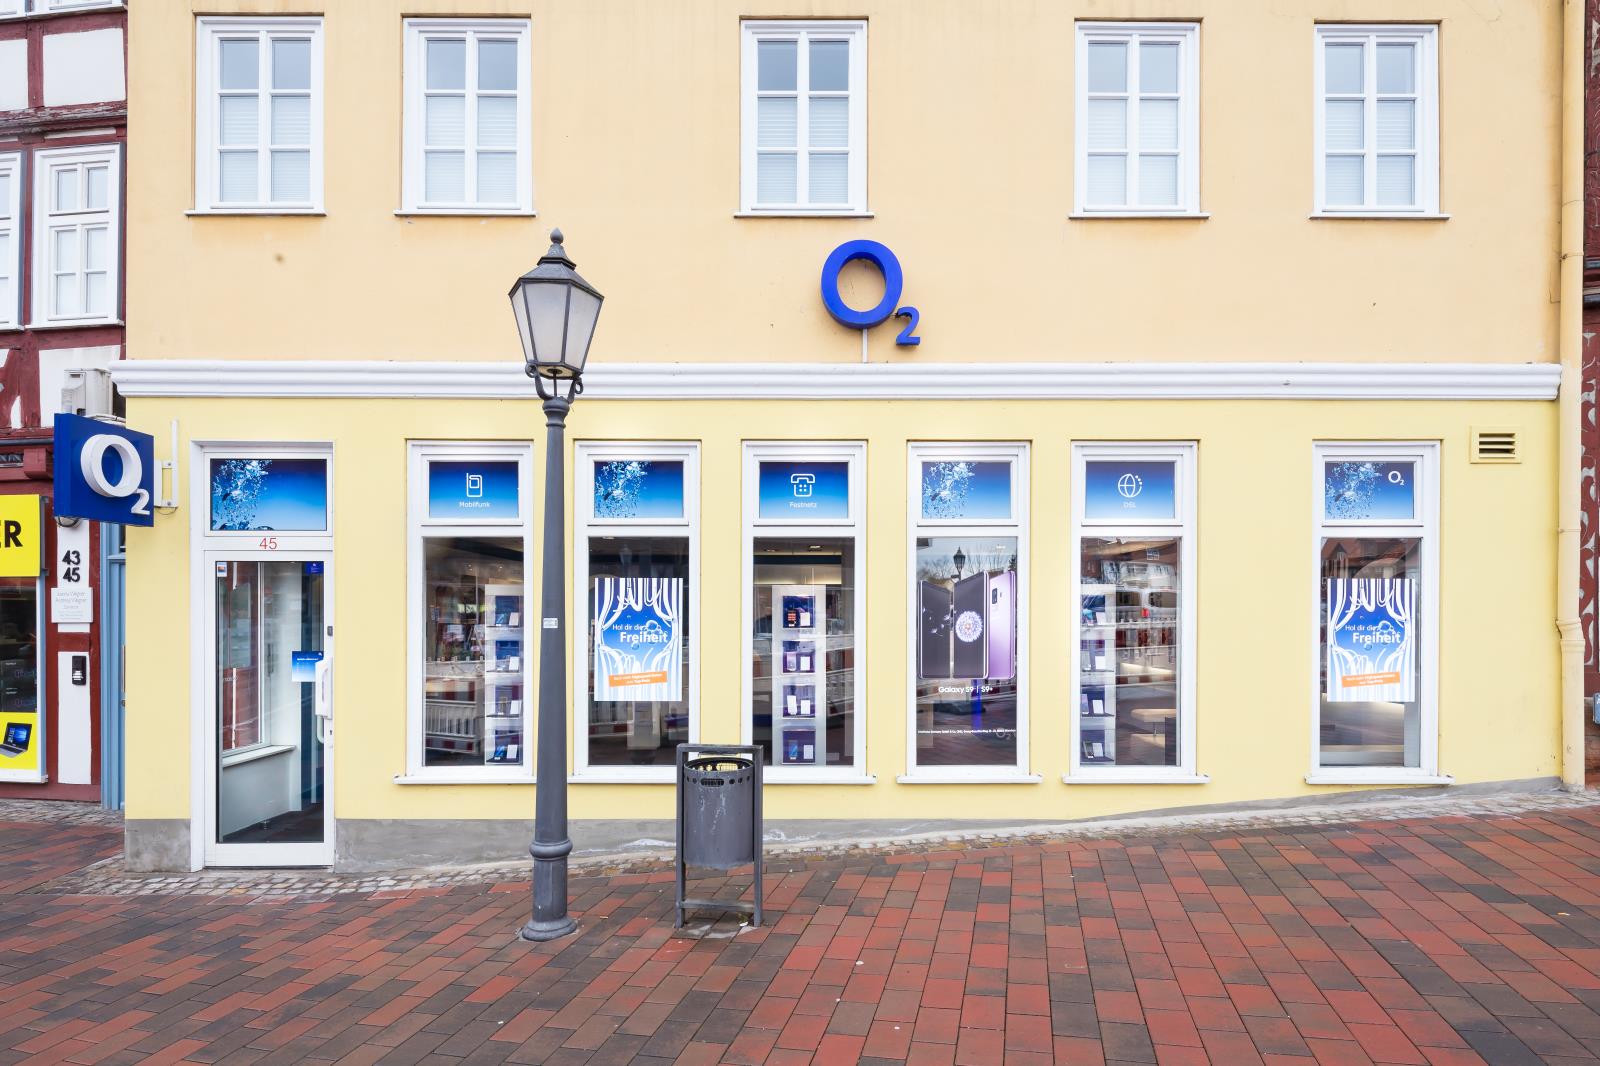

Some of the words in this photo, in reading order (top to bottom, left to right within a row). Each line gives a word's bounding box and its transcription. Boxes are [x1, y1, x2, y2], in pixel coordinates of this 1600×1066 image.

[820, 239, 921, 346] O2
[80, 433, 150, 516] O2
[0, 519, 24, 548] R
[259, 537, 277, 550] 45
[62, 550, 81, 565] 43
[62, 567, 81, 582] 45
[620, 631, 668, 643] Freiheit
[1353, 632, 1401, 643] Freiheit
[938, 686, 965, 694] Galaxy
